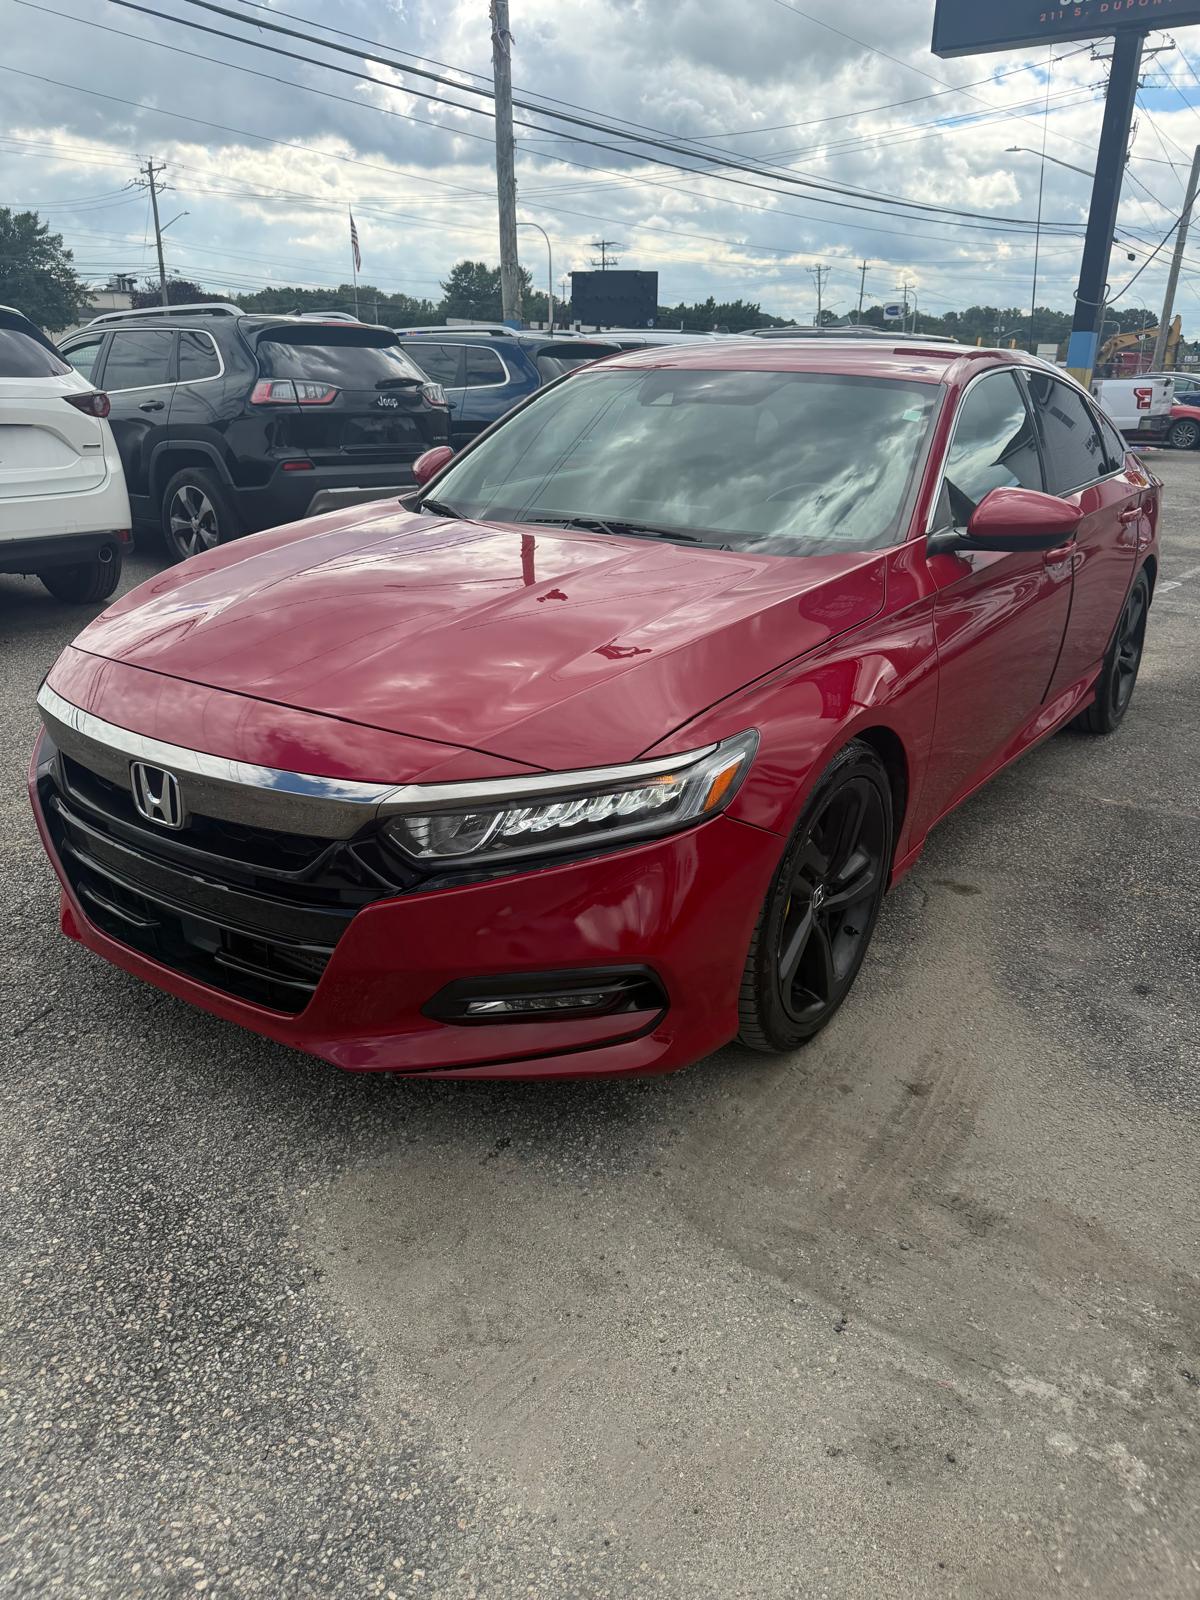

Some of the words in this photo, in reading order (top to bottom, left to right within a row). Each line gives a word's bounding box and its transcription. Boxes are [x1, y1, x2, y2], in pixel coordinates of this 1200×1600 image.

[1039, 10, 1063, 22] 211
[1073, 7, 1089, 17] S.
[1100, 0, 1172, 13] DUPON
[377, 396, 398, 408] Jeep
